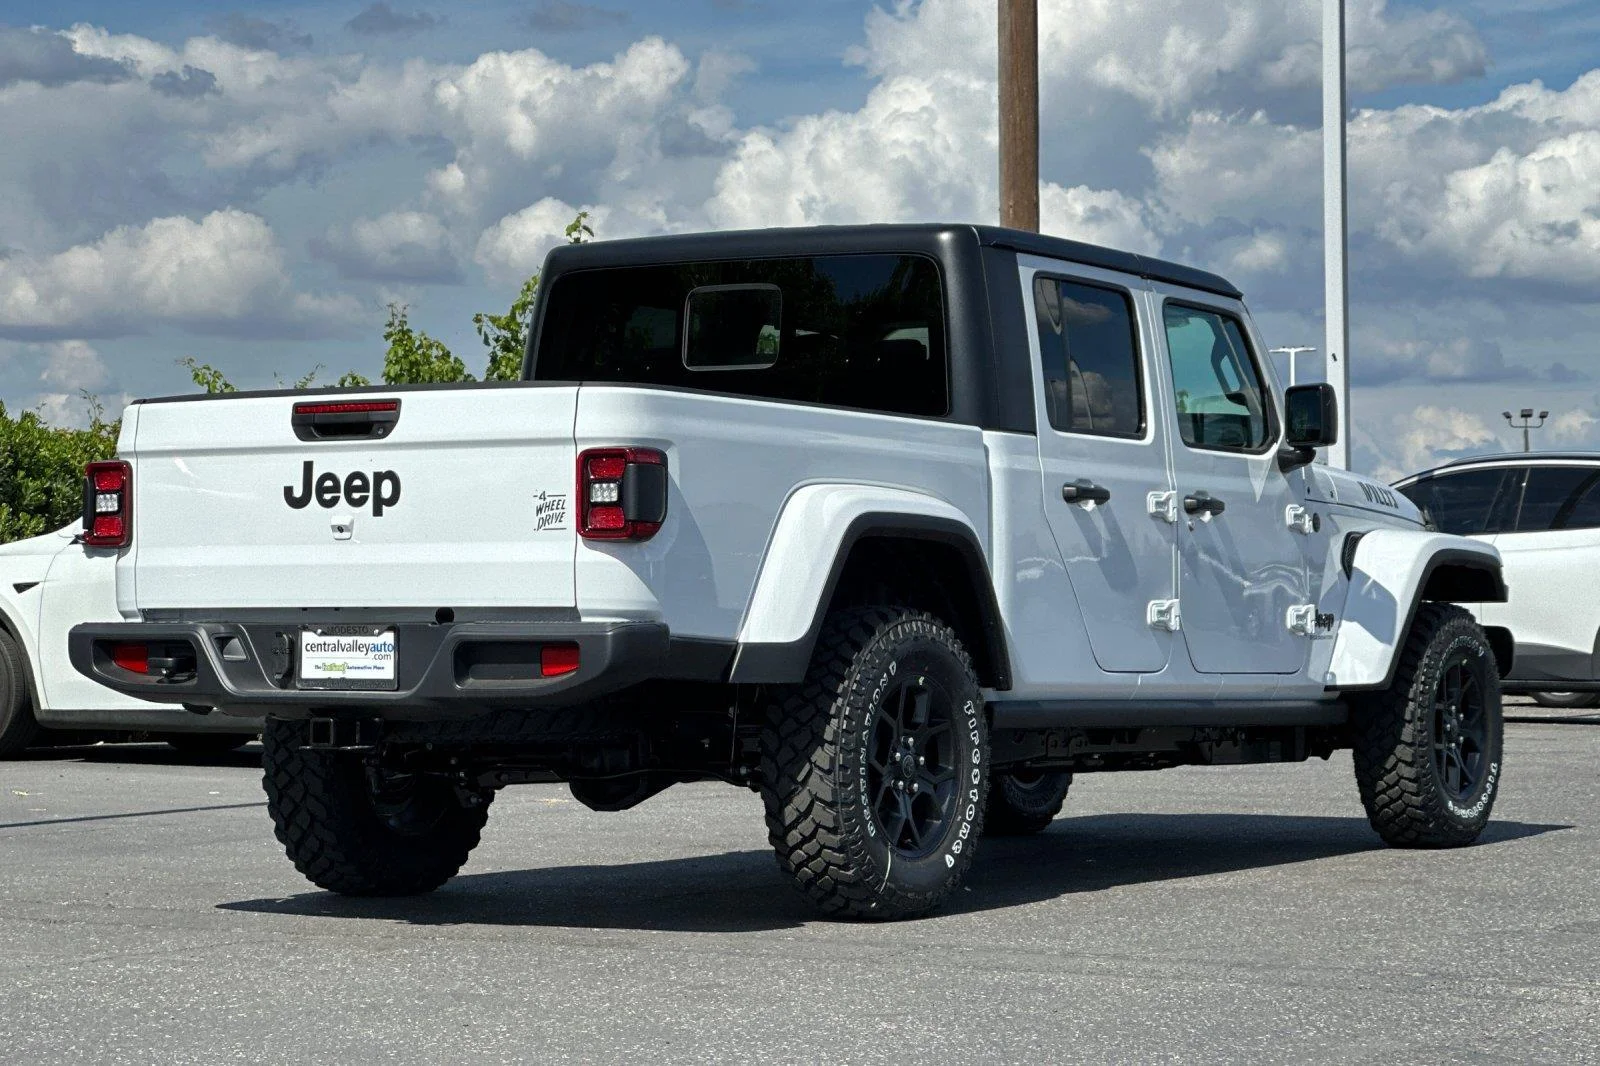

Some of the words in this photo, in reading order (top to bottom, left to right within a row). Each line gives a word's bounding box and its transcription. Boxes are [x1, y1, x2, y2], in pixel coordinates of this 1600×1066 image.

[283, 460, 401, 517] Jeep
[538, 490, 546, 501] 4
[1357, 481, 1398, 508] WILLYS
[536, 500, 566, 517] WHEEL
[536, 512, 566, 531] DRIVE
[304, 639, 395, 656] centralvalleyauto
